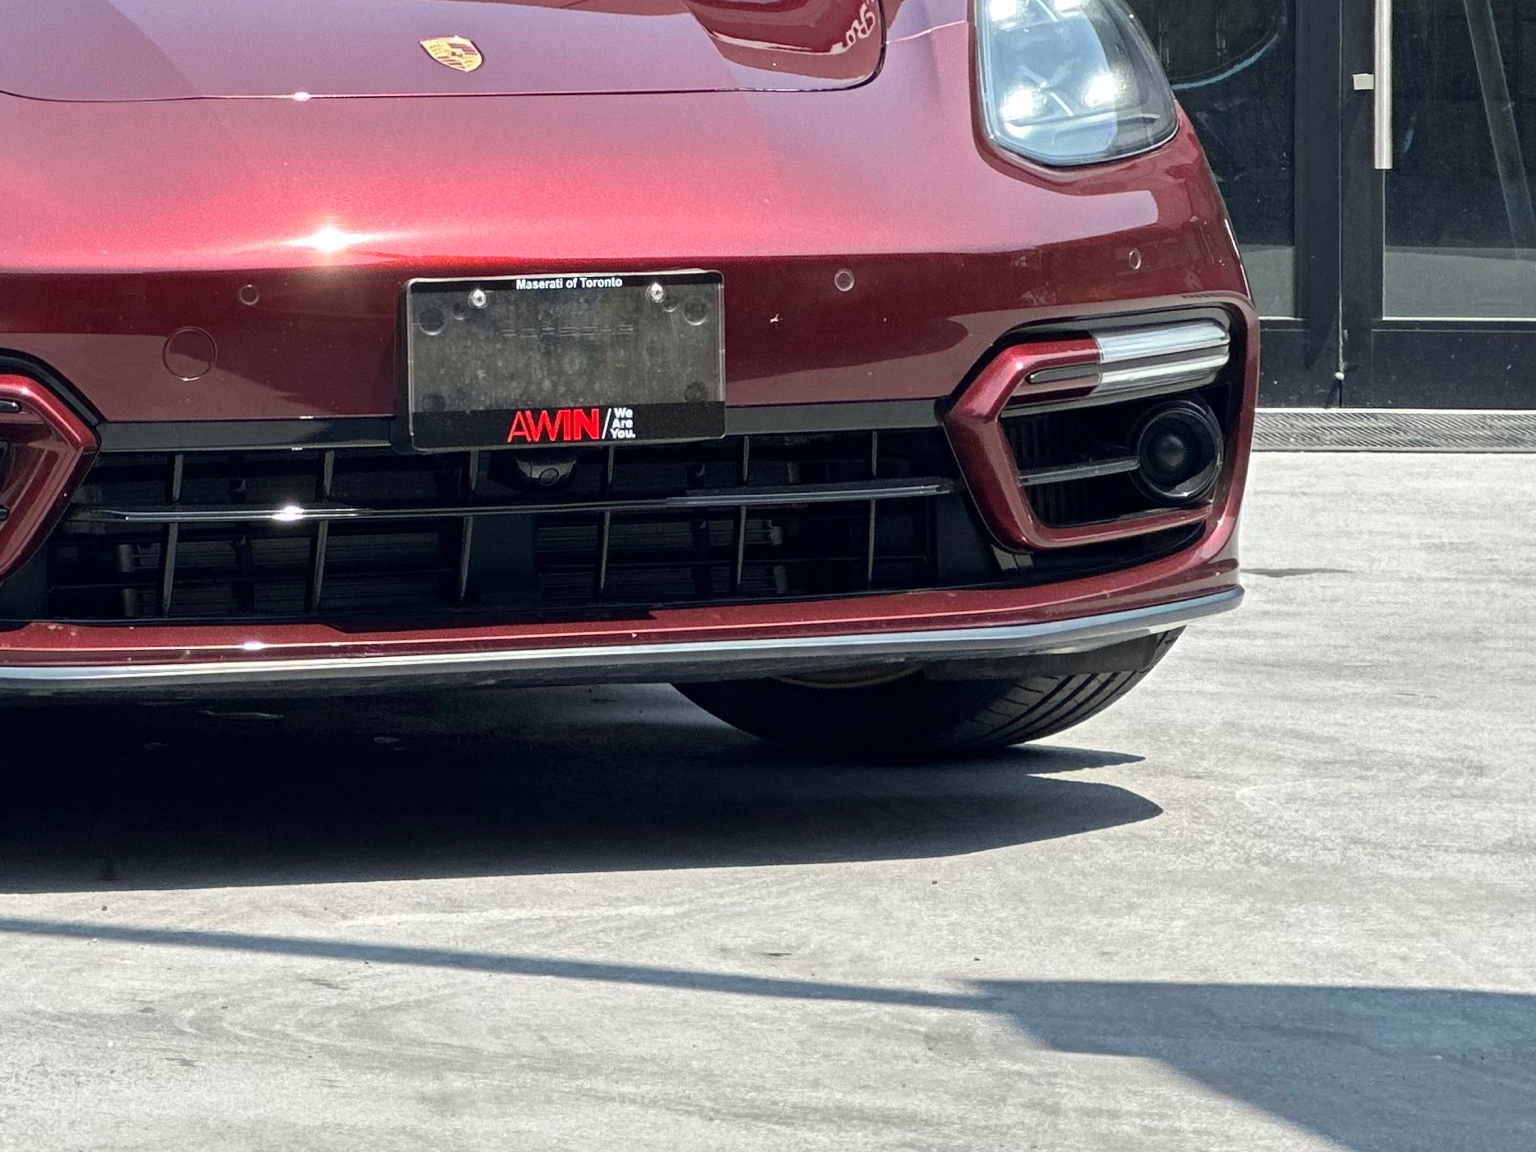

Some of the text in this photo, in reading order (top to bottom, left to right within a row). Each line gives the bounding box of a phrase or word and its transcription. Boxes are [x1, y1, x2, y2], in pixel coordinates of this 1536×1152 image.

[515, 276, 623, 290] Maserati of Toronto
[614, 407, 634, 419] We
[507, 408, 599, 443] AWIN
[611, 418, 634, 429] Are
